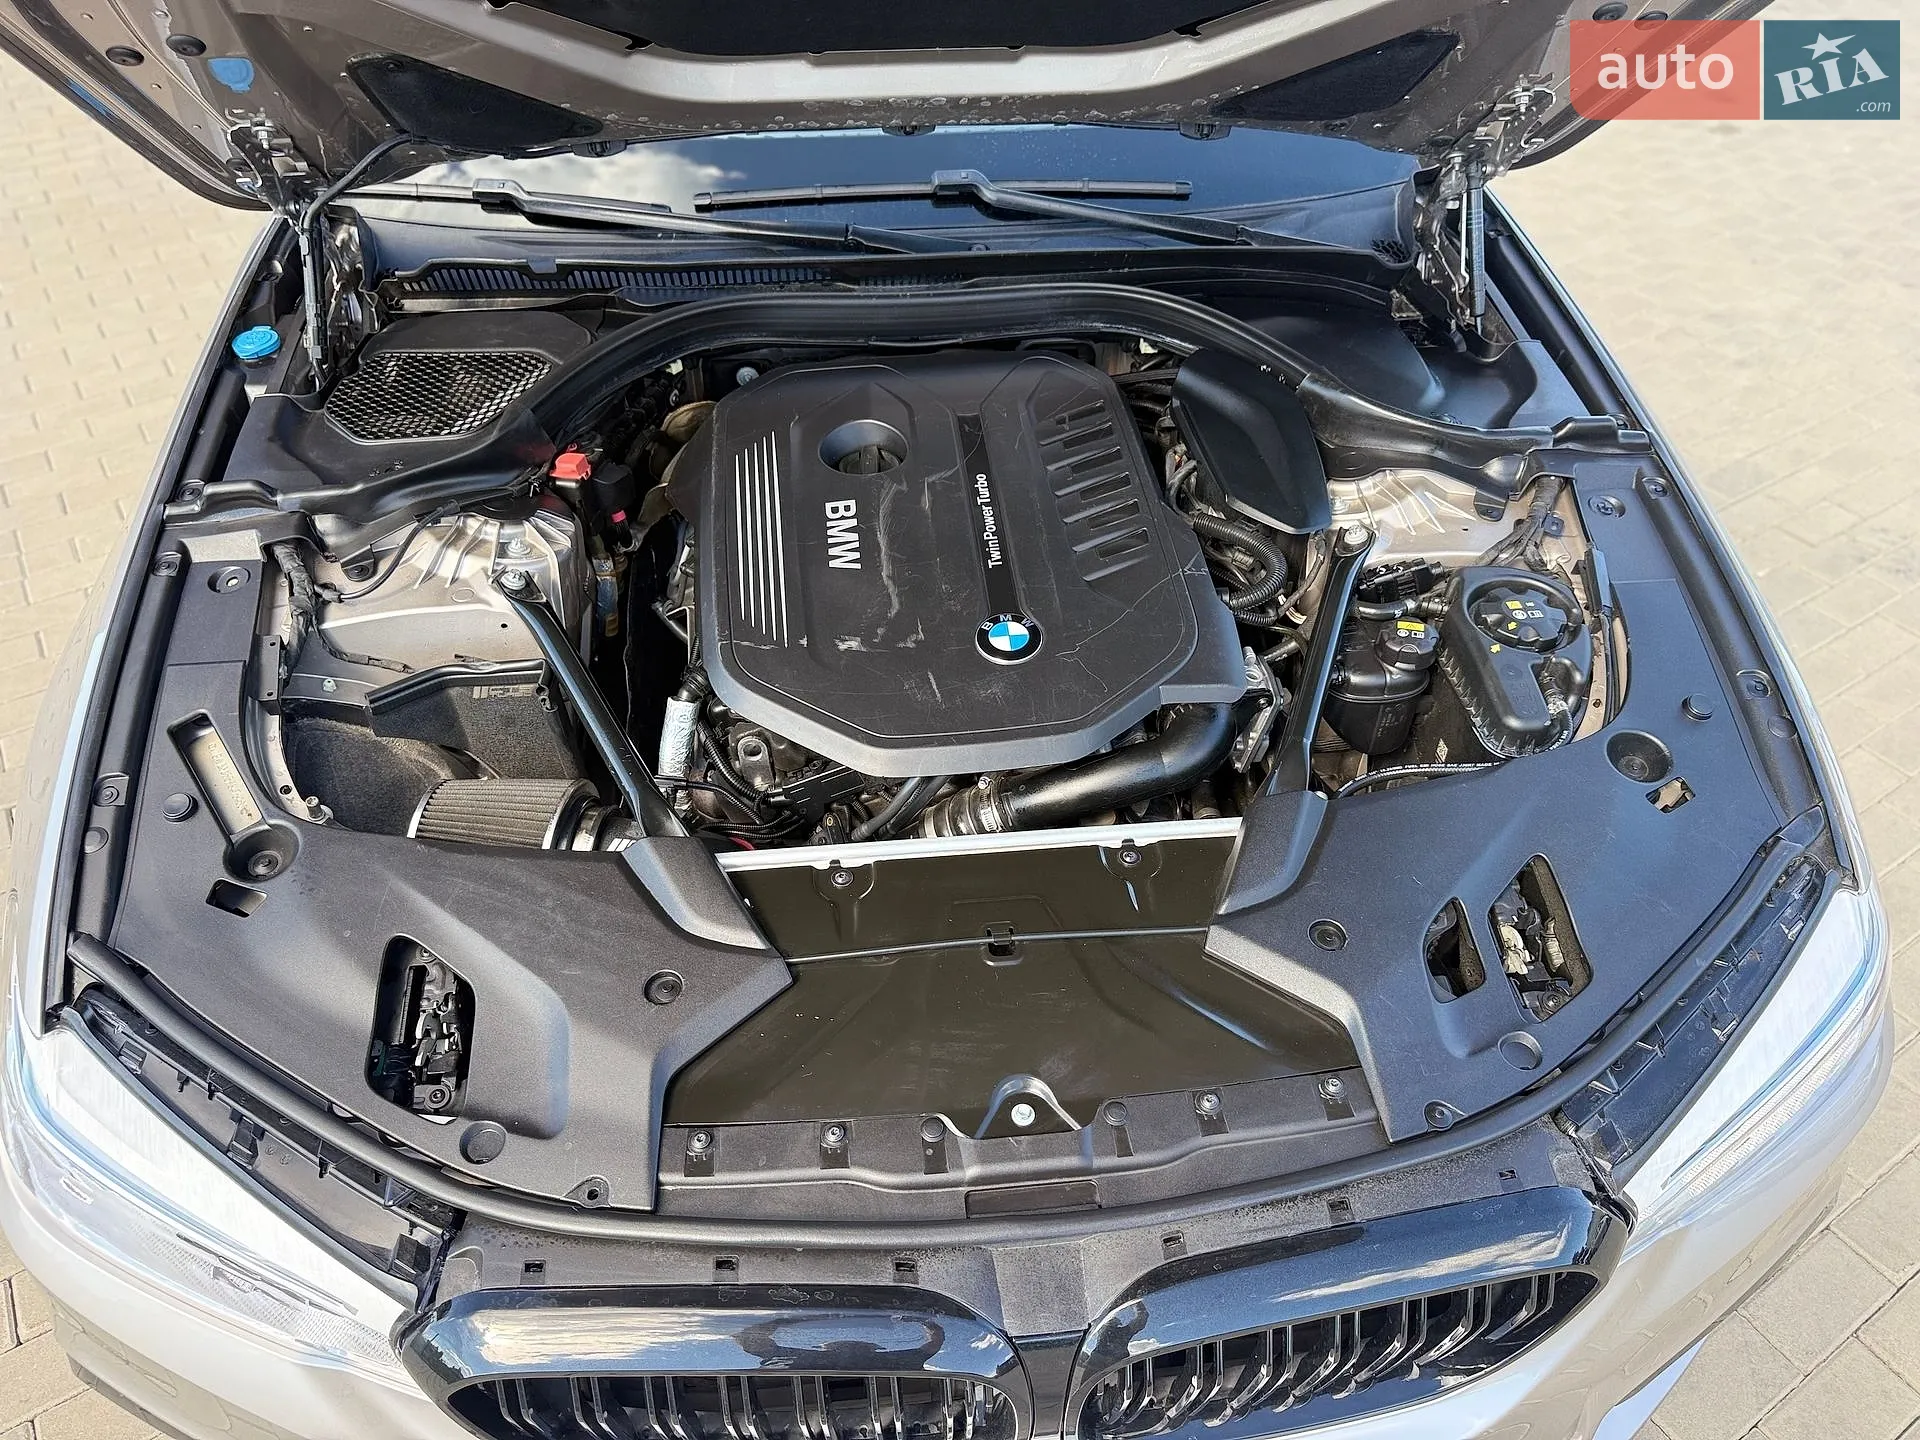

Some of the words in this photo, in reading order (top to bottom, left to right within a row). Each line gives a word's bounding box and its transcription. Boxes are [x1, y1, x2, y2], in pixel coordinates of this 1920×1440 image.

[974, 473, 991, 506] Turbo
[824, 499, 862, 570] BMW
[983, 505, 1003, 569] TwinPower
